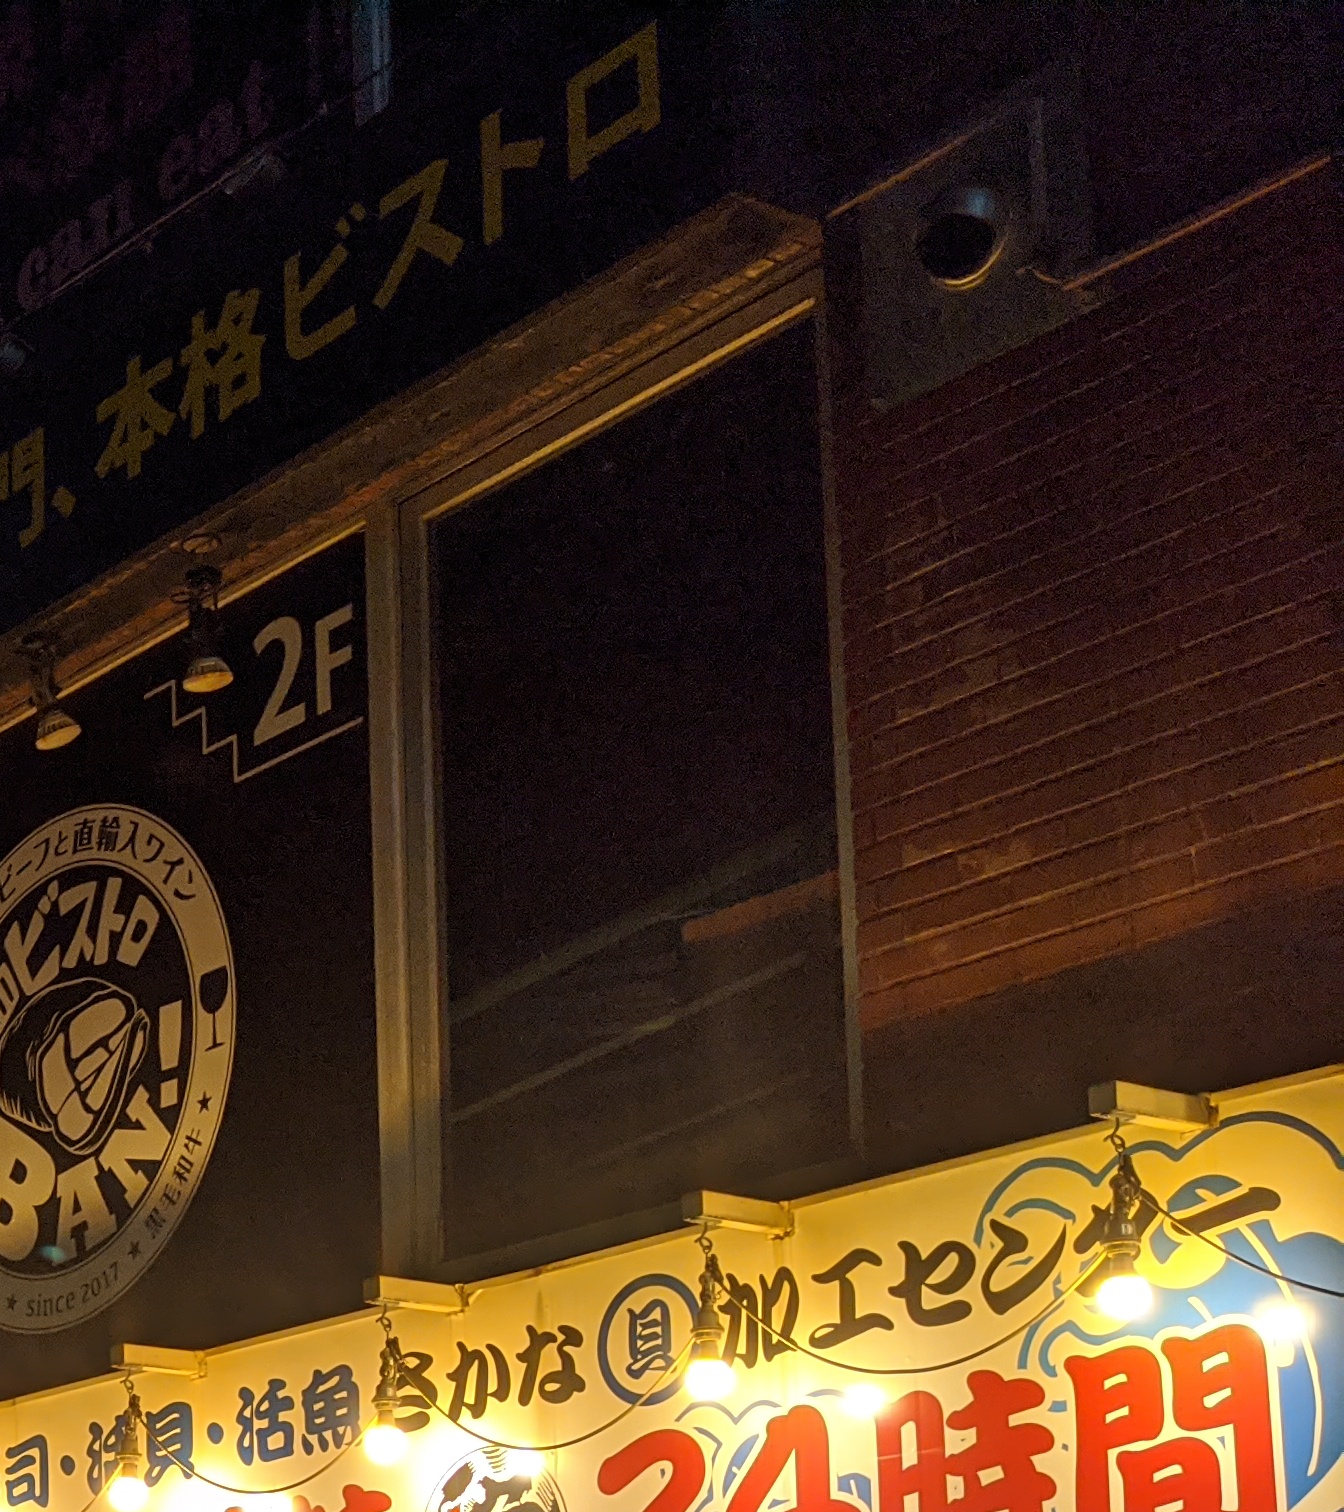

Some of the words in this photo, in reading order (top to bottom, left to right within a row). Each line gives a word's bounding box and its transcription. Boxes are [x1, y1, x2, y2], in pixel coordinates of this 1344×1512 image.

[253, 603, 353, 746] 2F
[25, 1292, 76, 1317] since
[81, 1263, 119, 1305] 2017
